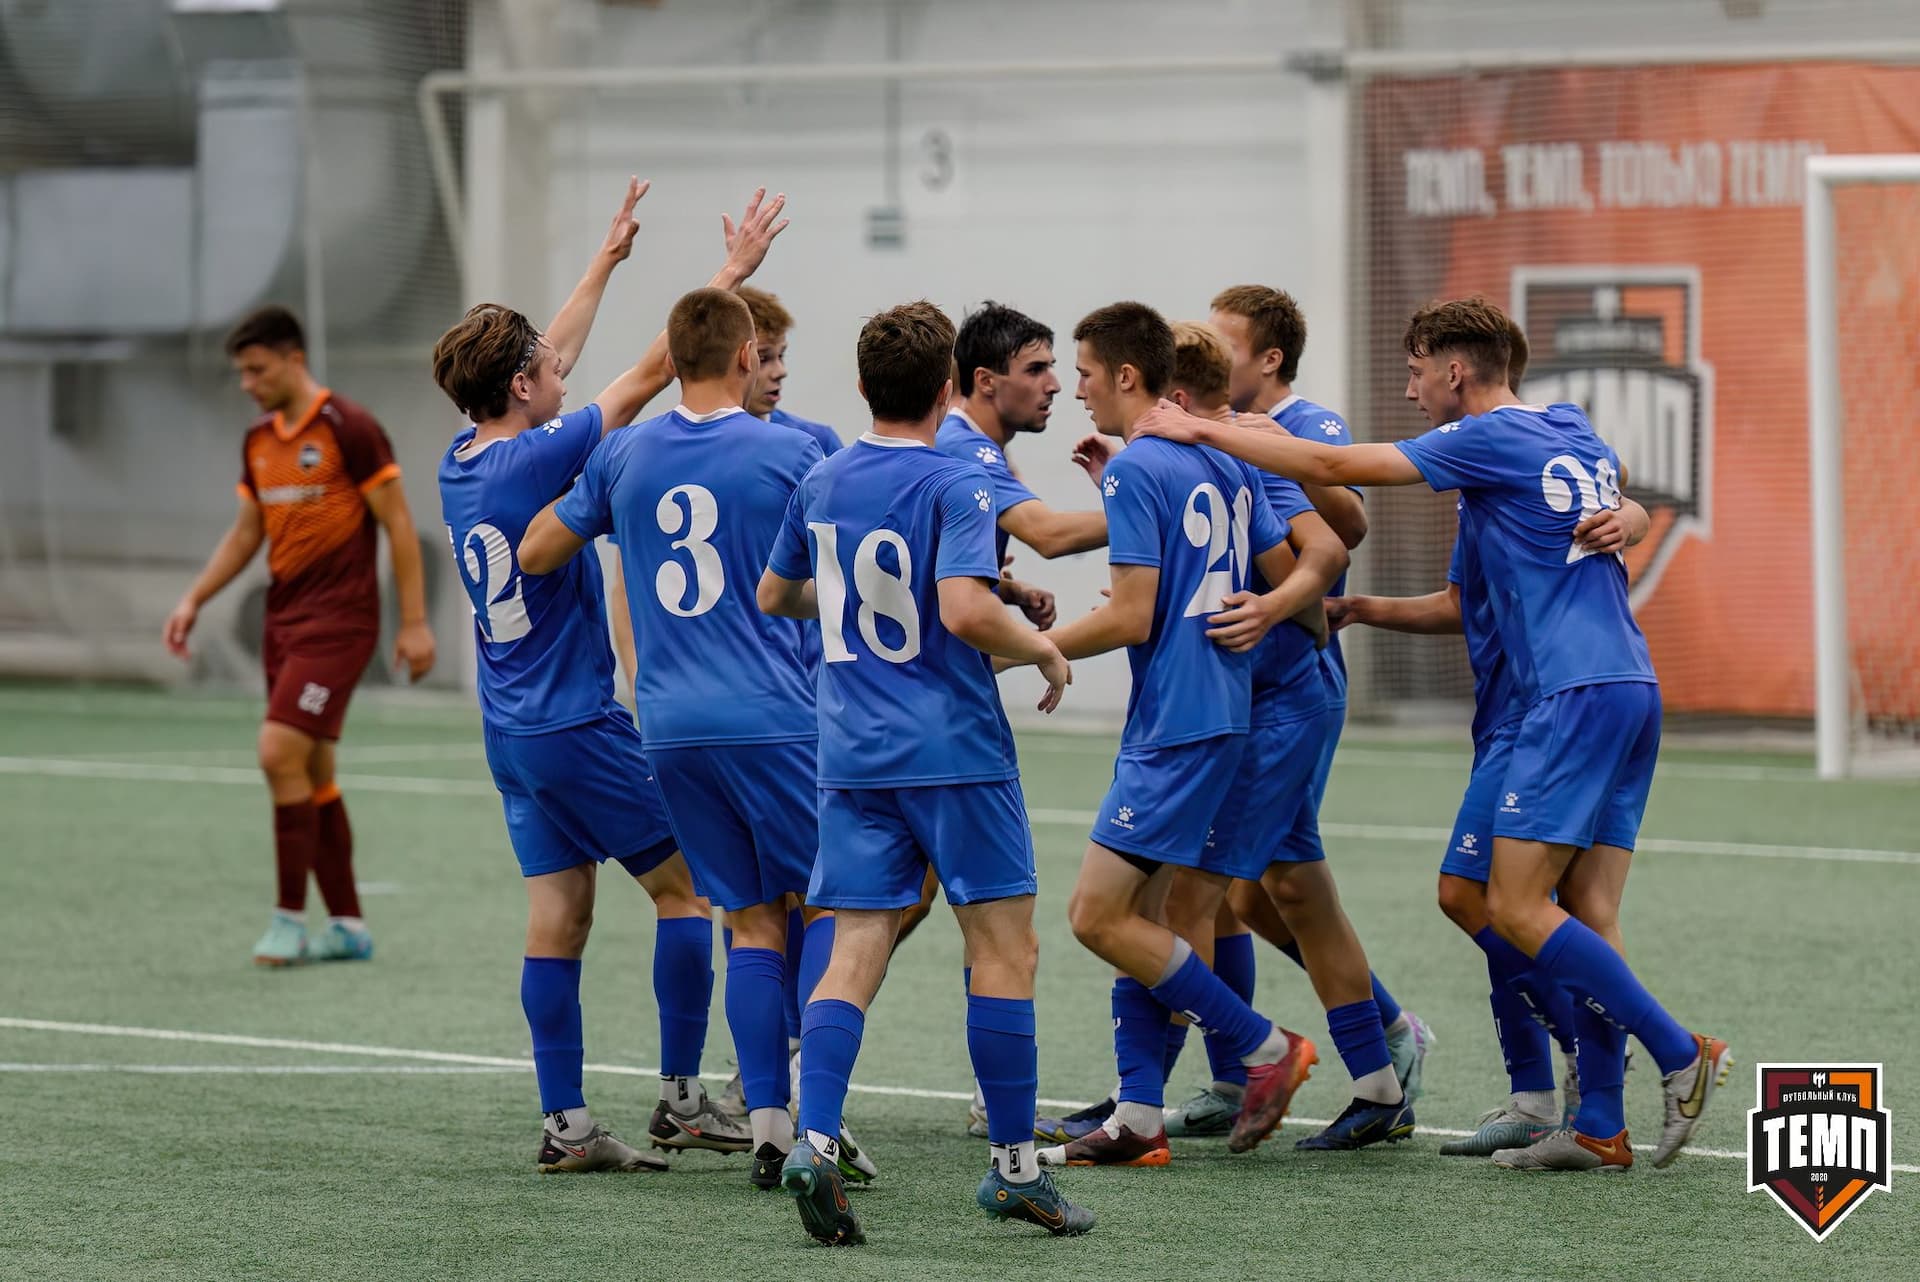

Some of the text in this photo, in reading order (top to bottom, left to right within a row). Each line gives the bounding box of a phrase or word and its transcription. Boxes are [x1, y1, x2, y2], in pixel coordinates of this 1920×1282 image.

[919, 127, 953, 193] 3
[1520, 368, 1696, 500] МП
[655, 484, 725, 618] 3
[807, 521, 921, 664] 18
